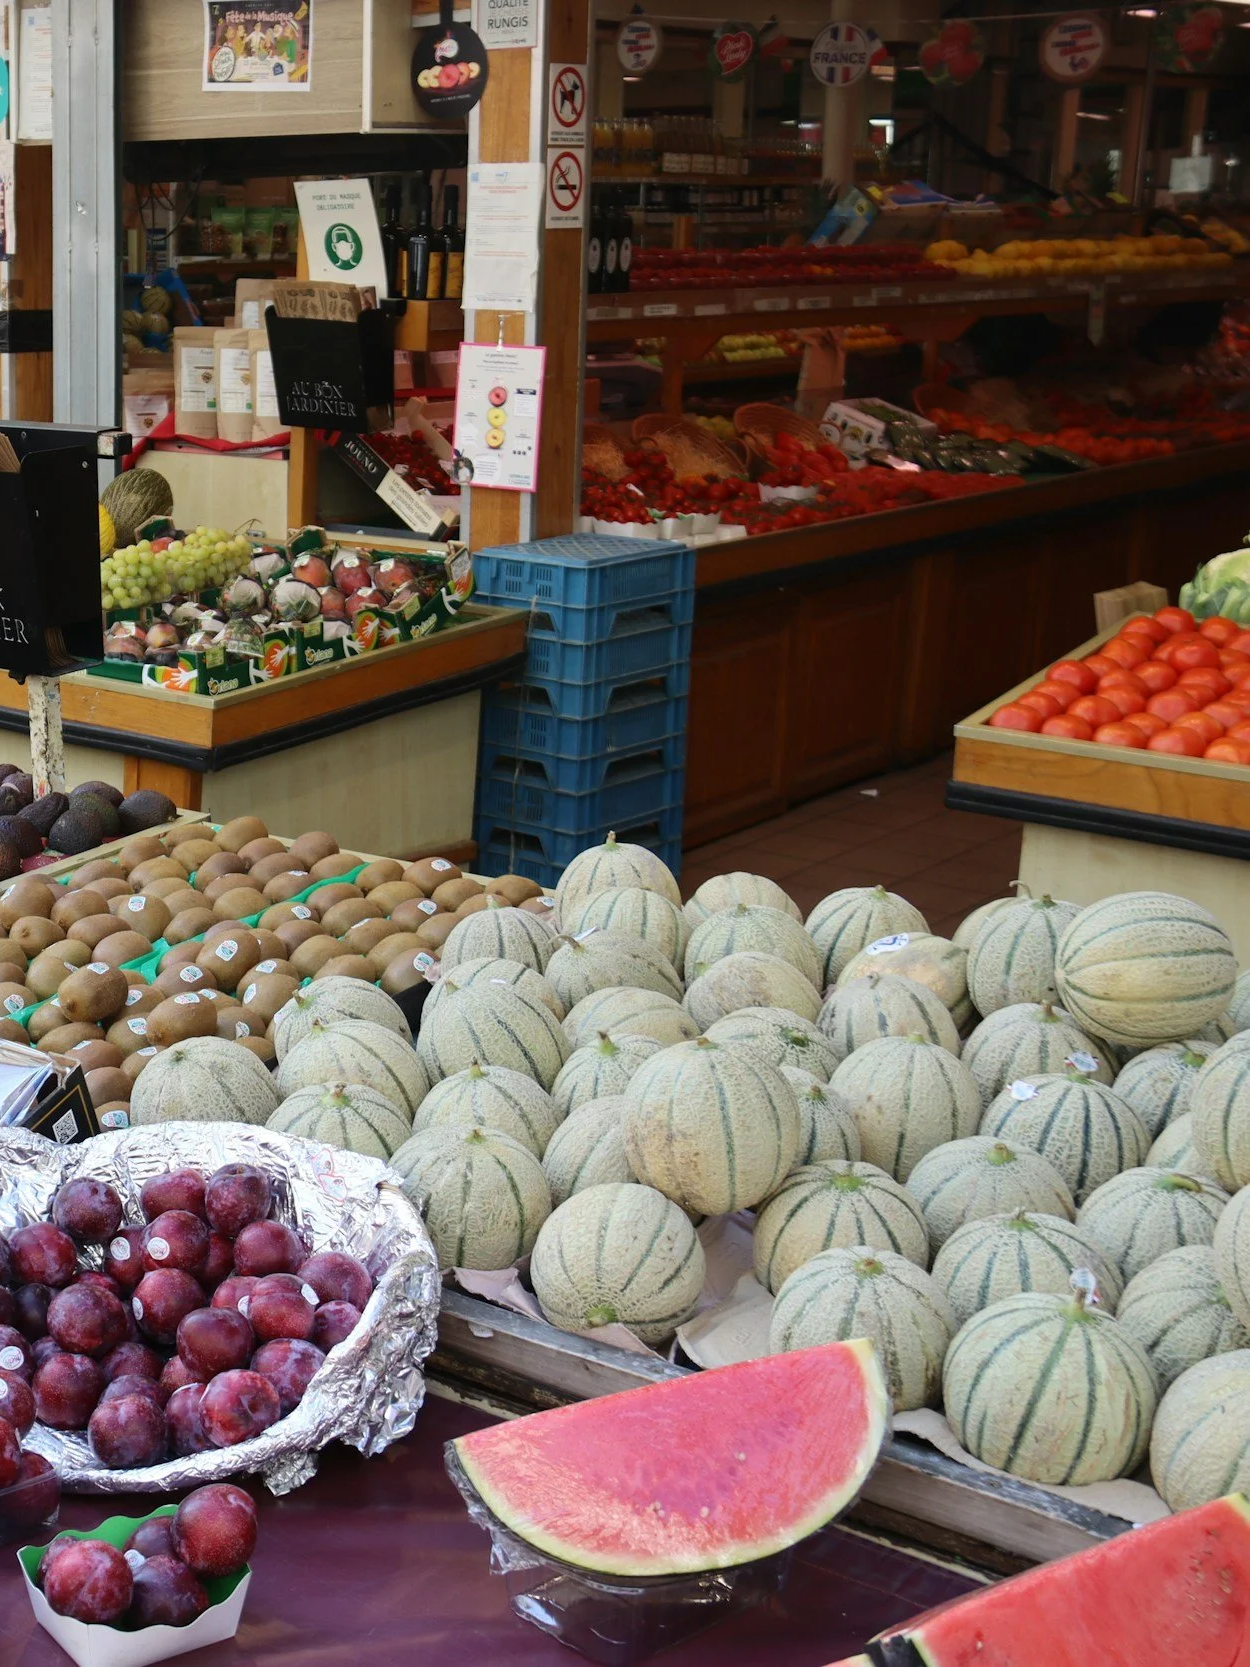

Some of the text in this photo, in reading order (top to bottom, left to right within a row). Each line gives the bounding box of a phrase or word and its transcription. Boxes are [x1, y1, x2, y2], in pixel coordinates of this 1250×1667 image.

[257, 10, 294, 25] Musique
[487, 16, 529, 29] RUNGIS
[814, 52, 867, 65] FRANCE
[339, 192, 362, 200] MASQUE
[316, 203, 355, 211] OBLIGATOIRE
[291, 381, 343, 399] AU BON
[286, 395, 357, 417] JARDINIER
[344, 440, 378, 474] JOUNO
